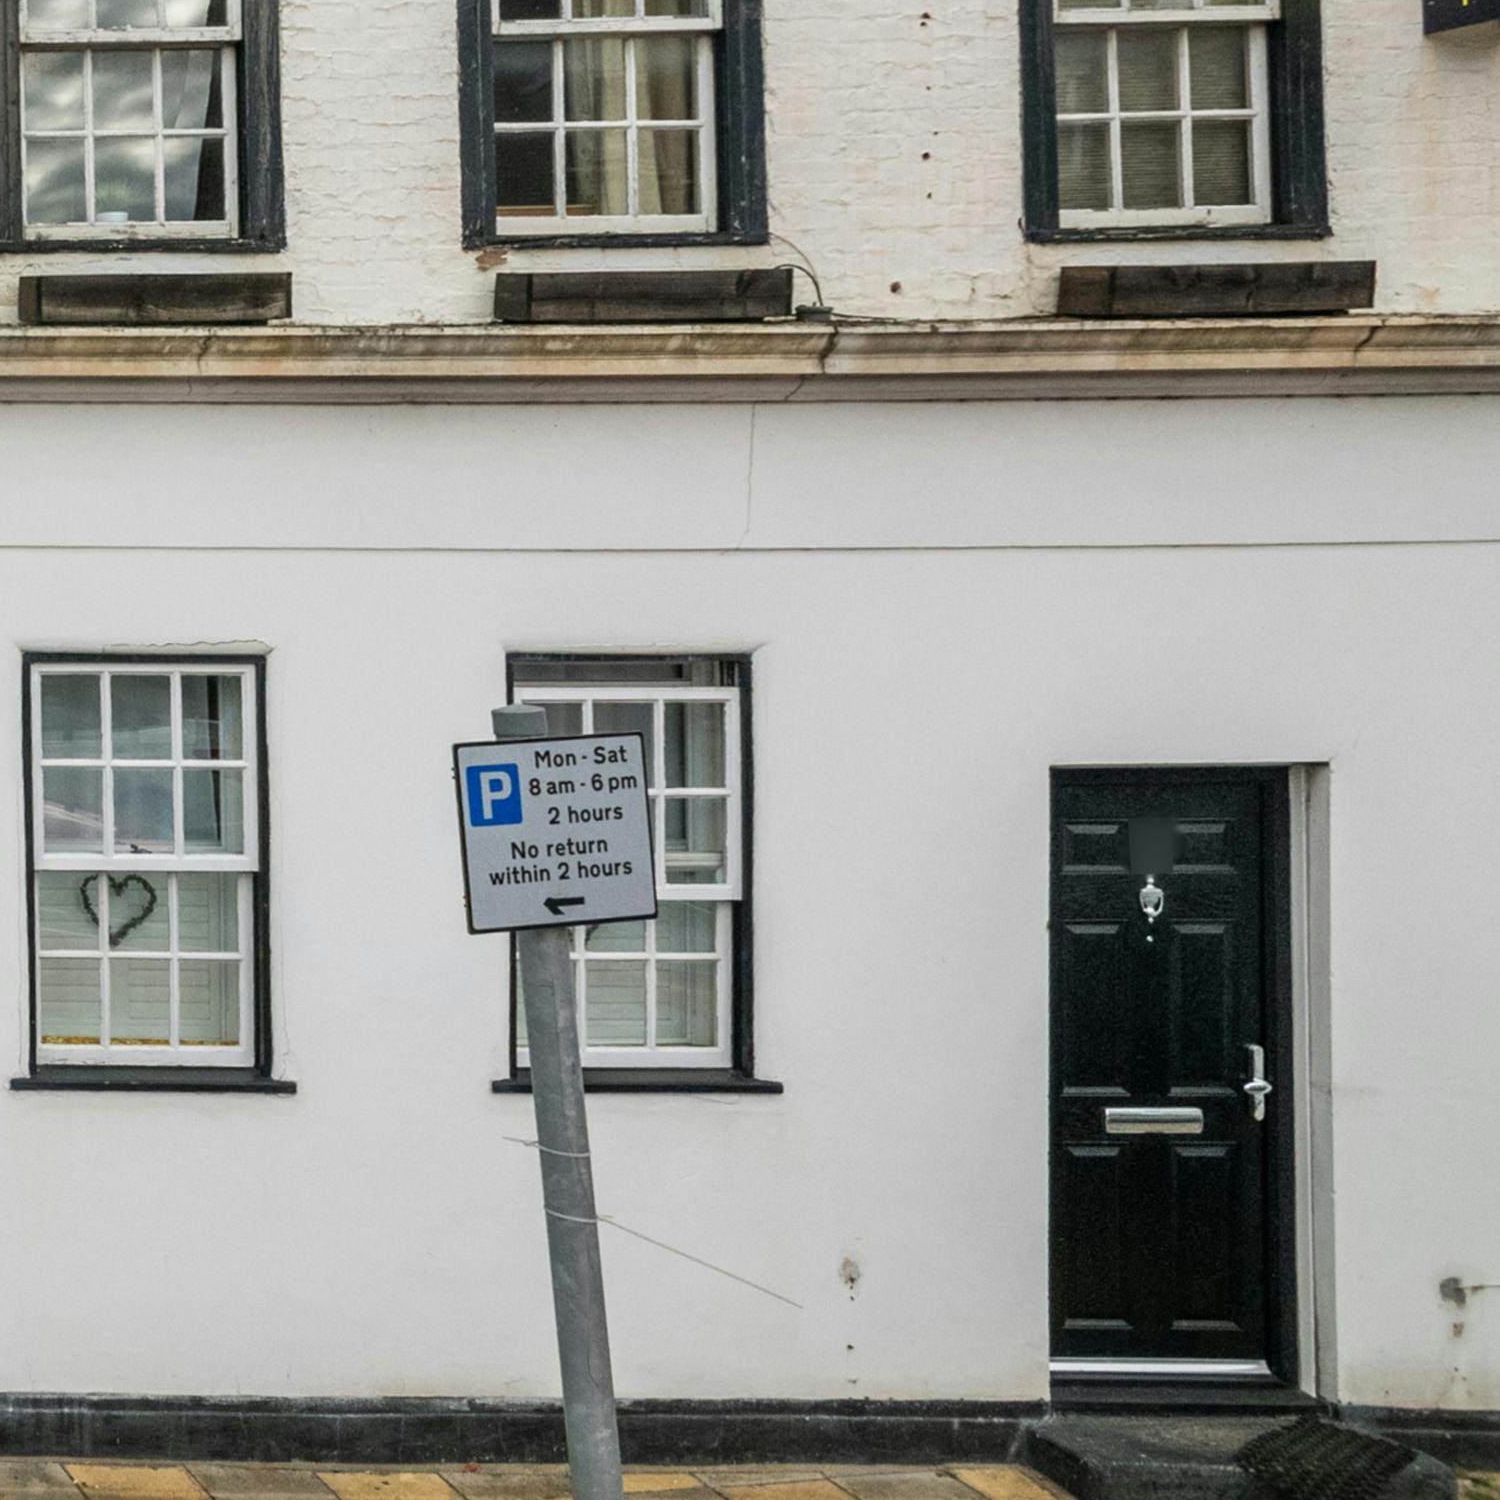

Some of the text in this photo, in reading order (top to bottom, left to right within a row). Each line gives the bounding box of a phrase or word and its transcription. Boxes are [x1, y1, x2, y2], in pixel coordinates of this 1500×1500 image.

[534, 750, 577, 769] Mon
[593, 745, 628, 765] Sat
[480, 771, 512, 820] P
[529, 778, 542, 796] 8
[546, 781, 576, 796] am
[591, 773, 604, 792] 6
[608, 775, 638, 794] pm
[548, 805, 624, 825] 2 hours
[510, 838, 608, 860] No return
[489, 860, 633, 886] within 2 hours
